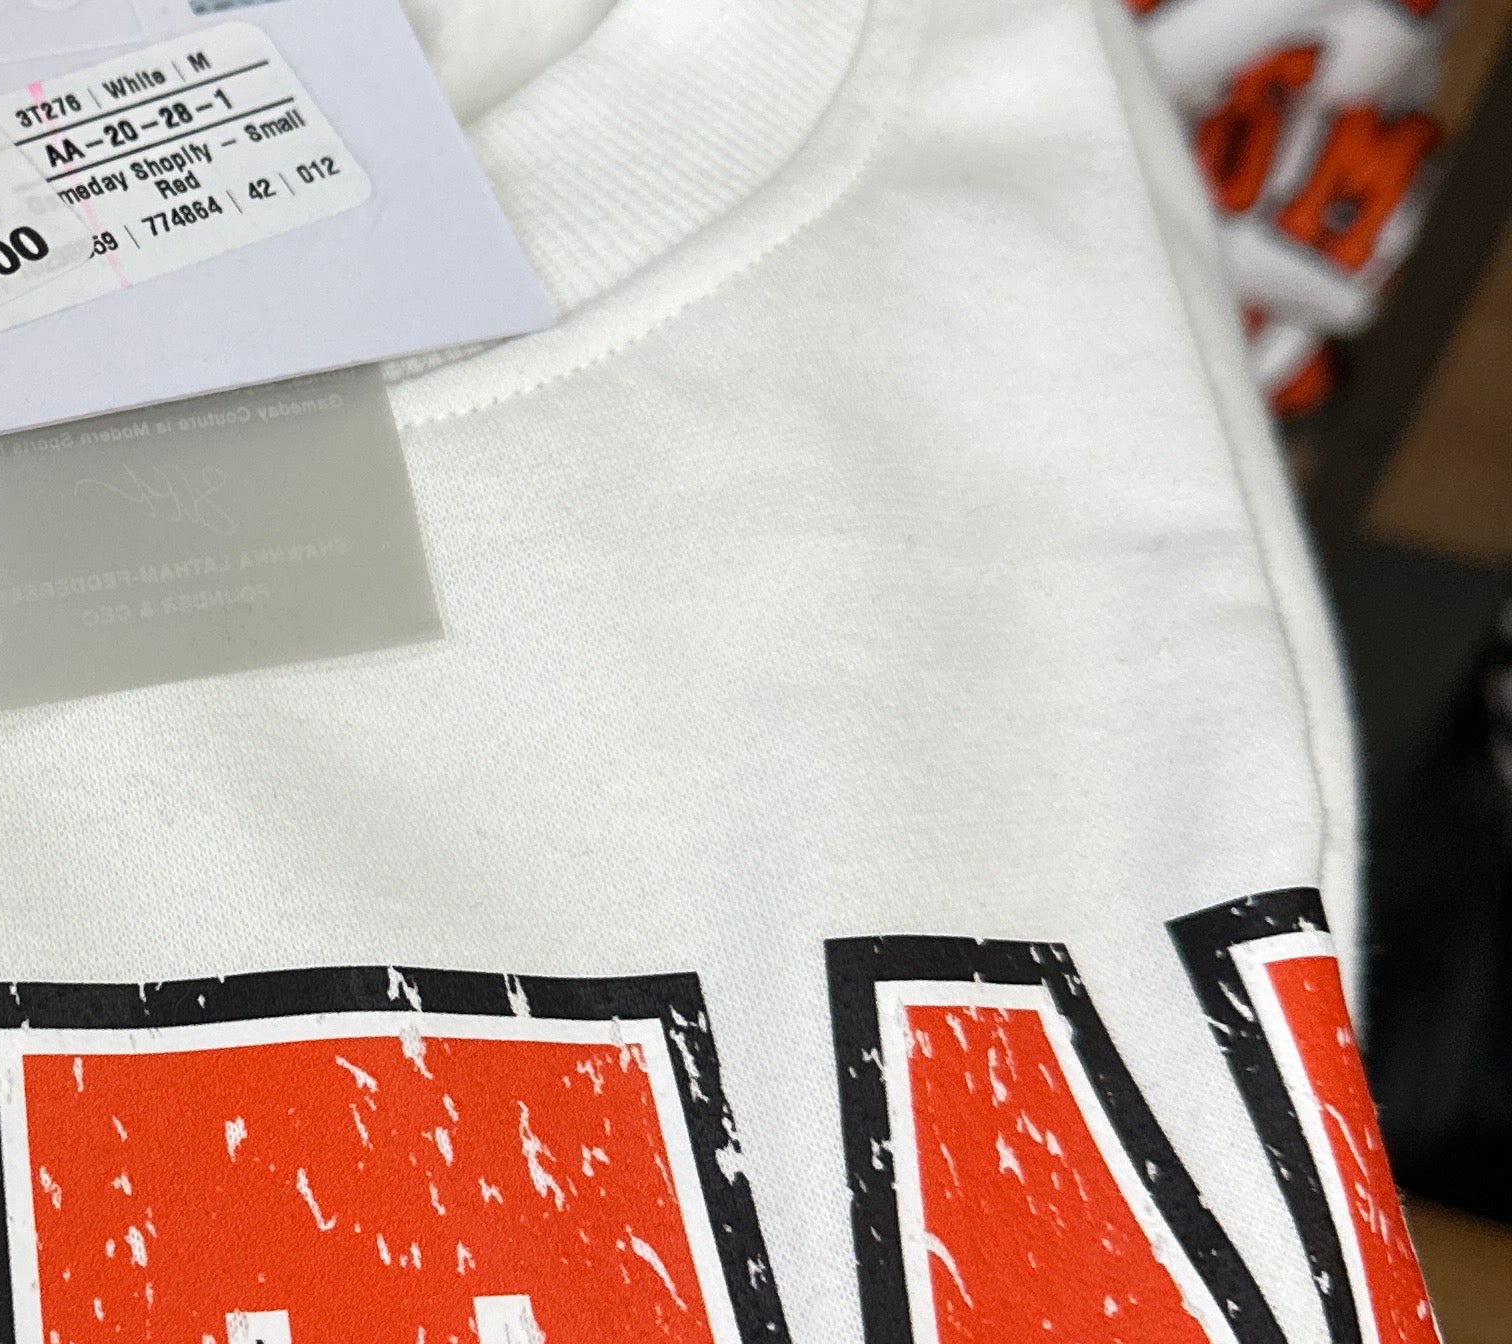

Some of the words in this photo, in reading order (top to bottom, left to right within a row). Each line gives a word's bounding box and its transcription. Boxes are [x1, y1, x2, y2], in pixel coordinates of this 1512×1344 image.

[102, 67, 166, 100] White
[187, 51, 212, 73] M
[44, 88, 233, 168] AA-20-28-1
[130, 139, 213, 181] Shopify
[247, 107, 306, 142] Small
[140, 194, 224, 237] 774864
[247, 178, 277, 202] 42
[296, 155, 341, 186] 012
[154, 172, 201, 200] Red
